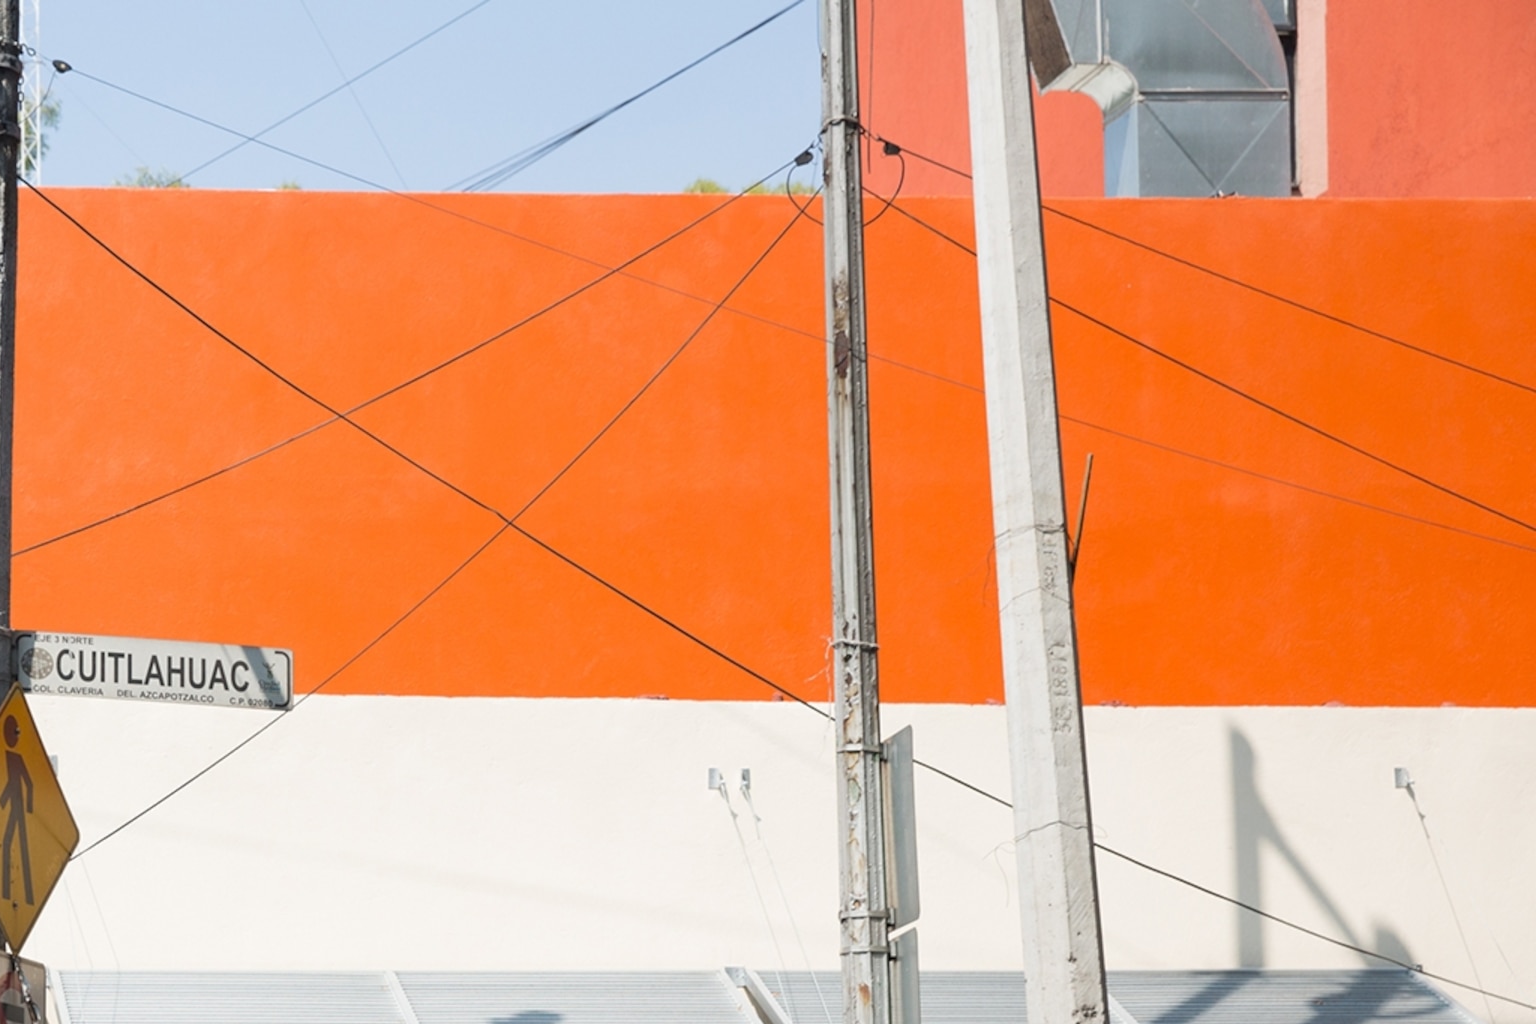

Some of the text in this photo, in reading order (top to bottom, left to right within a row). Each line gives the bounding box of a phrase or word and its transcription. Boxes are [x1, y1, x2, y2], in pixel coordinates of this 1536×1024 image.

[35, 634, 52, 643] EJE
[62, 636, 94, 645] NORTE
[56, 649, 250, 693] CUITLAHUAC
[57, 685, 104, 696] CLAVERIA
[140, 691, 214, 704] AZCAPOTZALCO
